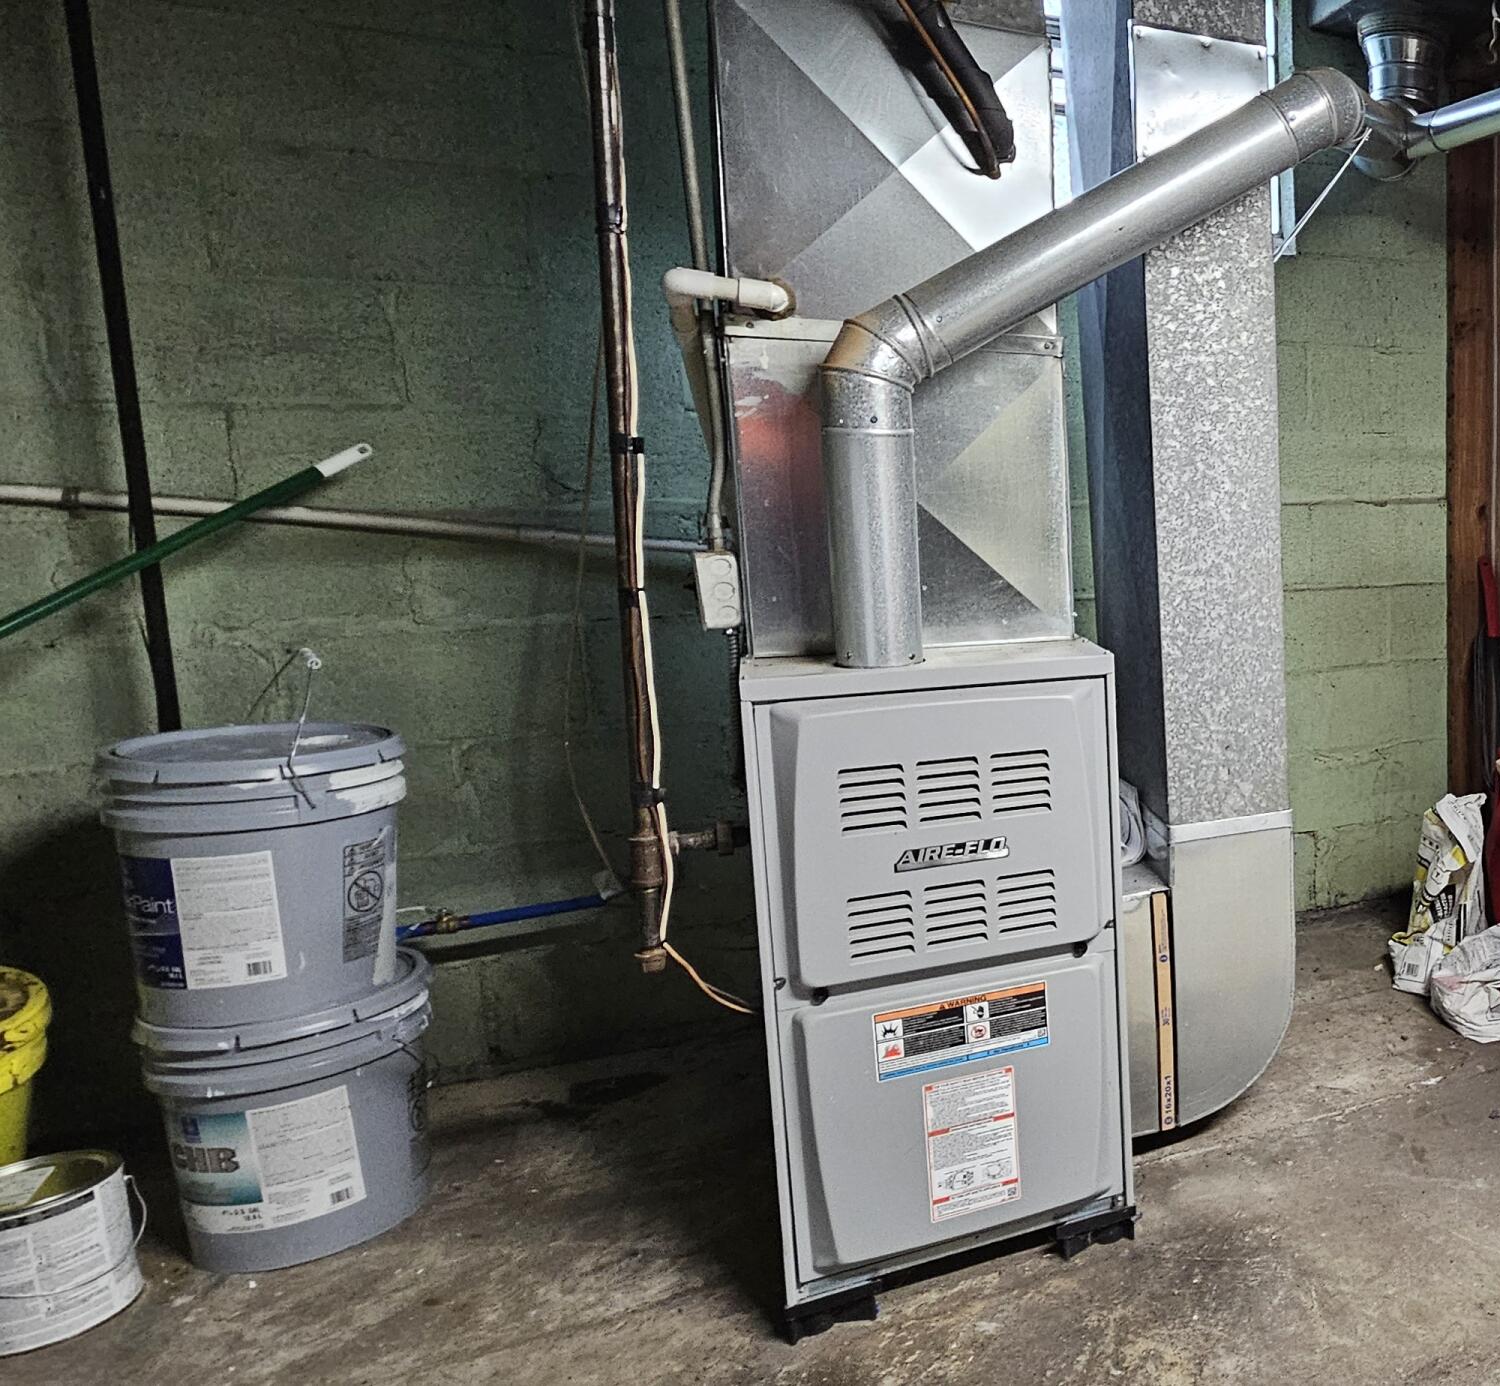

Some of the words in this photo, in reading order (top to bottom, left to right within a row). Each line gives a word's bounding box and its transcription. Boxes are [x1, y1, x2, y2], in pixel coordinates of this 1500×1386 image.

[898, 836, 1007, 867] AIRE-FLO
[946, 994, 988, 1008] WARNING
[1164, 1075, 1173, 1114] 16x20x1
[172, 1142, 241, 1174] CHB
